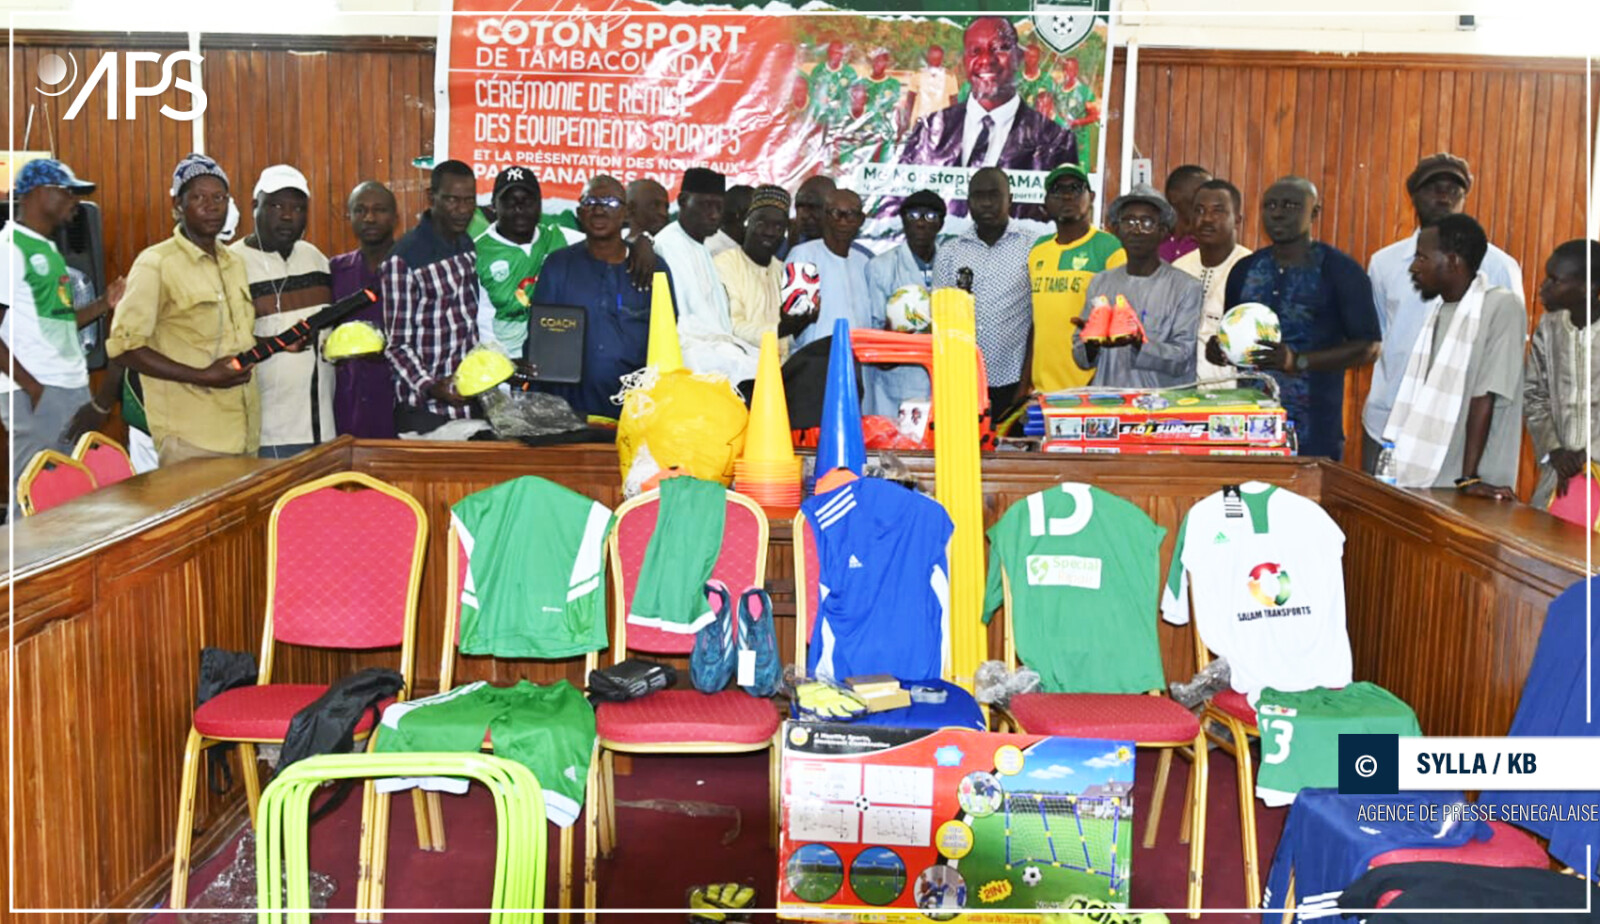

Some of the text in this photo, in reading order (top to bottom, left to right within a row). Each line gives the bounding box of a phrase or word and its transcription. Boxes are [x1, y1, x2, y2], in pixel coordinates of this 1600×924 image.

[476, 18, 747, 54] COTON SPORT
[476, 46, 716, 75] DE TAMBACOUNDA
[475, 73, 692, 117] CÉRÉMONIE DE REMISE
[475, 109, 741, 155] DES ÉQUIPEMENTS SPORTIFS
[473, 149, 491, 161] ET
[494, 150, 513, 162] LA
[515, 149, 622, 168] PRÉSENTATION
[625, 156, 655, 169] DES
[473, 162, 638, 184] PAEANAIES
[1045, 276, 1069, 293] TAMBA
[540, 317, 577, 328] COACH
[1237, 606, 1312, 622] SALAM TRANSPORTS
